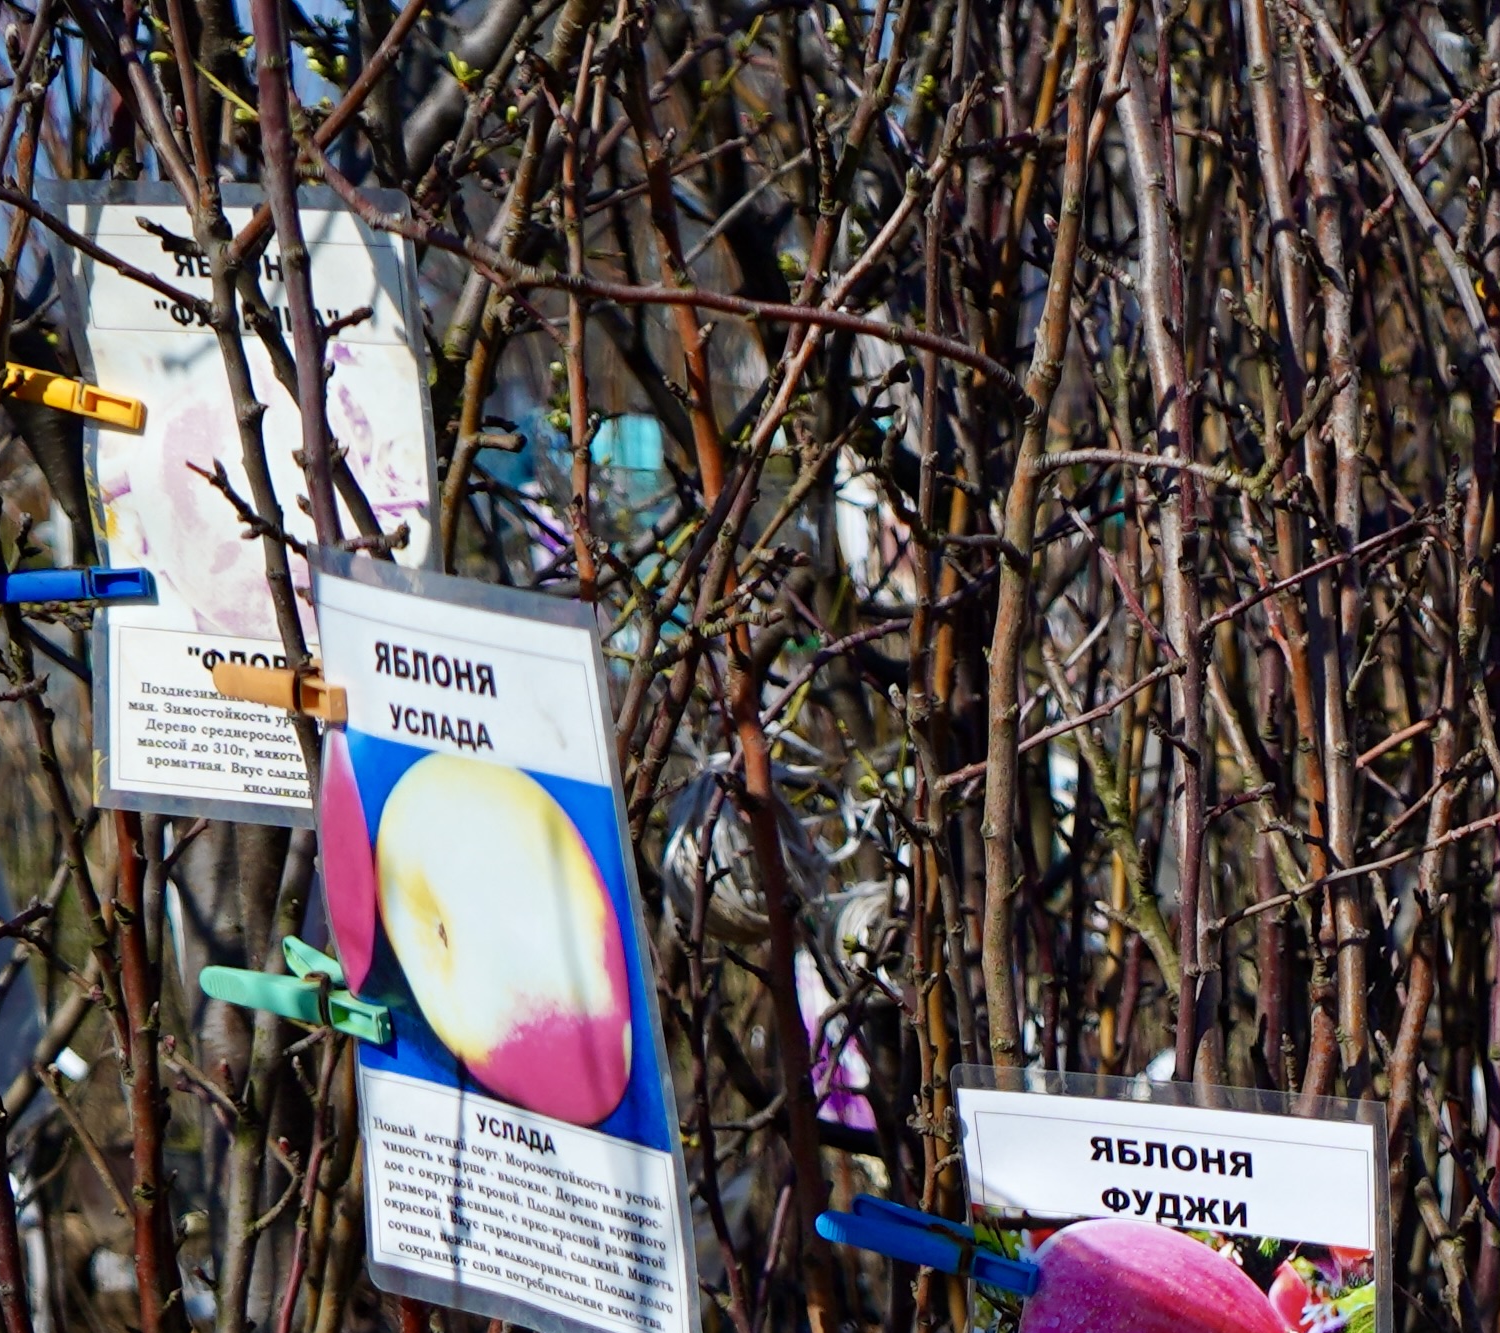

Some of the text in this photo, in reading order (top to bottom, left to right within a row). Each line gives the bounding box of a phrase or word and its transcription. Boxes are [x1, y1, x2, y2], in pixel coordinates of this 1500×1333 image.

[374, 640, 497, 699] ЯБЛОНЯ
[127, 701, 158, 712] мая.
[163, 701, 272, 724] Зимостойкость
[144, 717, 298, 746] Дерево среднерослое,
[388, 701, 495, 753] УСЛАДА
[136, 737, 304, 762] массой до 310г, мякоть
[146, 756, 264, 778] ароматная. Вкус
[476, 1113, 556, 1156] УСЛАДА
[1090, 1135, 1253, 1179] ЯБЛОНЯ
[372, 1116, 666, 1210] Новый летний сорт. Морозостойкость и устой-
[381, 1140, 434, 1162] чивость
[436, 1153, 446, 1166] к
[447, 1156, 486, 1176] парше
[497, 1171, 552, 1196] высокие.
[554, 1185, 598, 1210] Дерево
[601, 1203, 662, 1230] низкорос-
[383, 1159, 666, 1252] лое с округлой кроной. Плоды очень крупного
[387, 1179, 666, 1270] размера, красивые, с ярко-красной размытой
[1101, 1186, 1248, 1228] ФУДЖИ
[383, 1197, 674, 1292] окраской. Вкус гармоничный, сладкий. Мякоть
[387, 1219, 674, 1314] сочная, нежная, мелкозернистая. Плоды долго
[398, 1242, 666, 1332] сохраняют свои потребительские качества.
